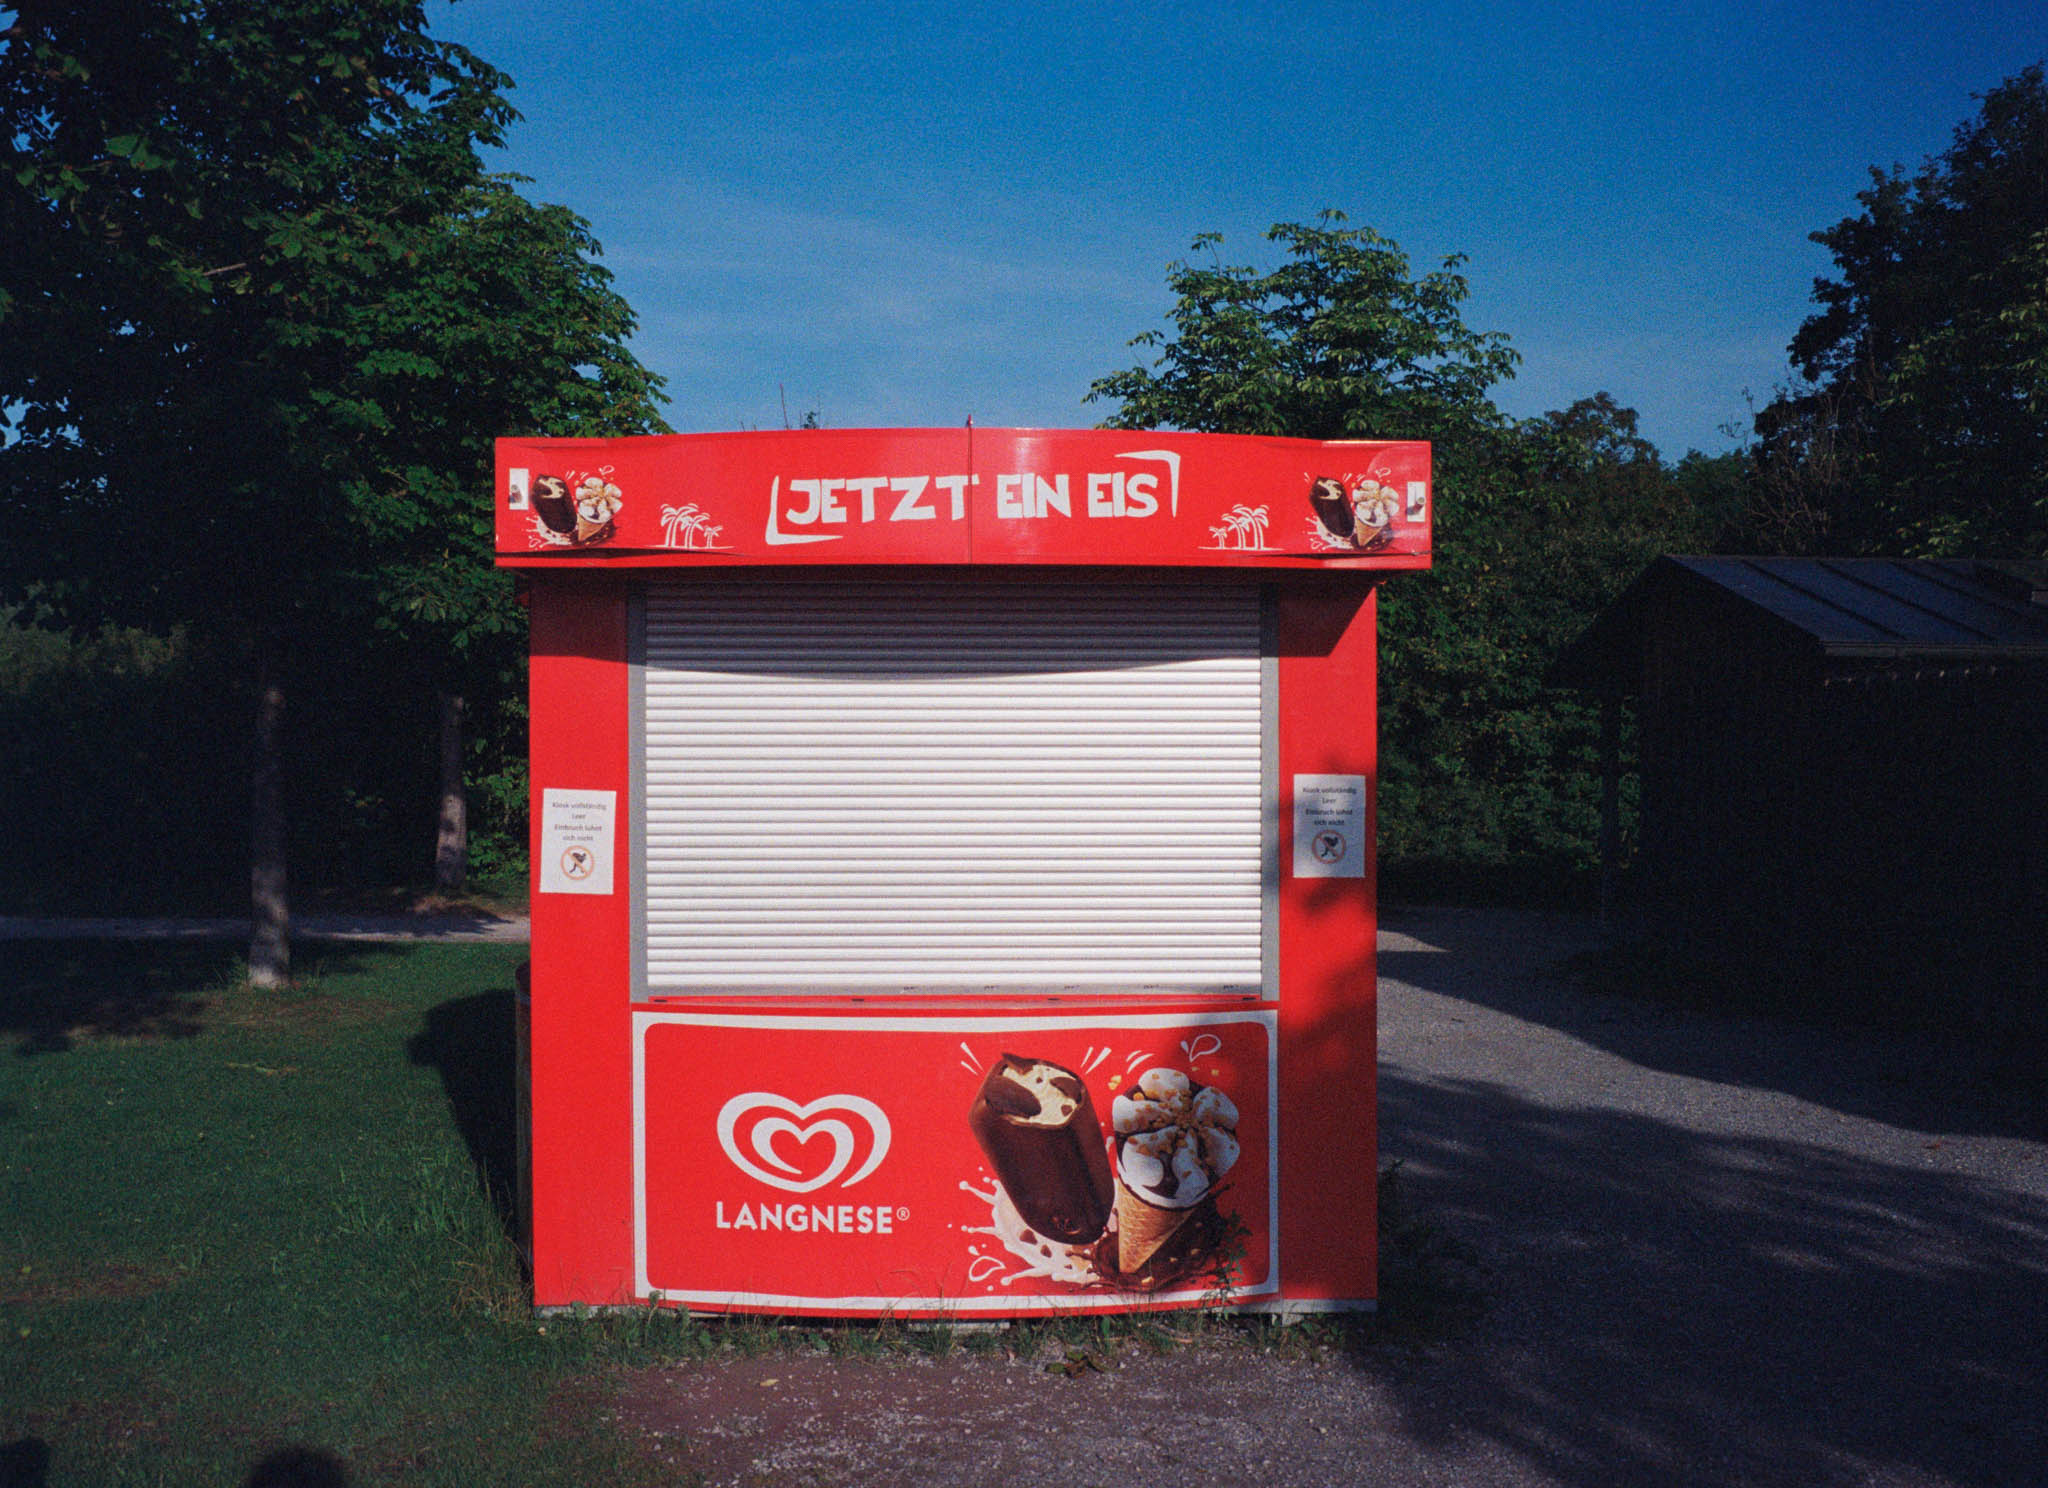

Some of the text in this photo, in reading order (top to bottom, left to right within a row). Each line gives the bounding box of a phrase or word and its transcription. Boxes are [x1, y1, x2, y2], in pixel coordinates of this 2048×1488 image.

[786, 471, 1159, 524] JETZT EIN EIS
[552, 801, 569, 809] Kiosk
